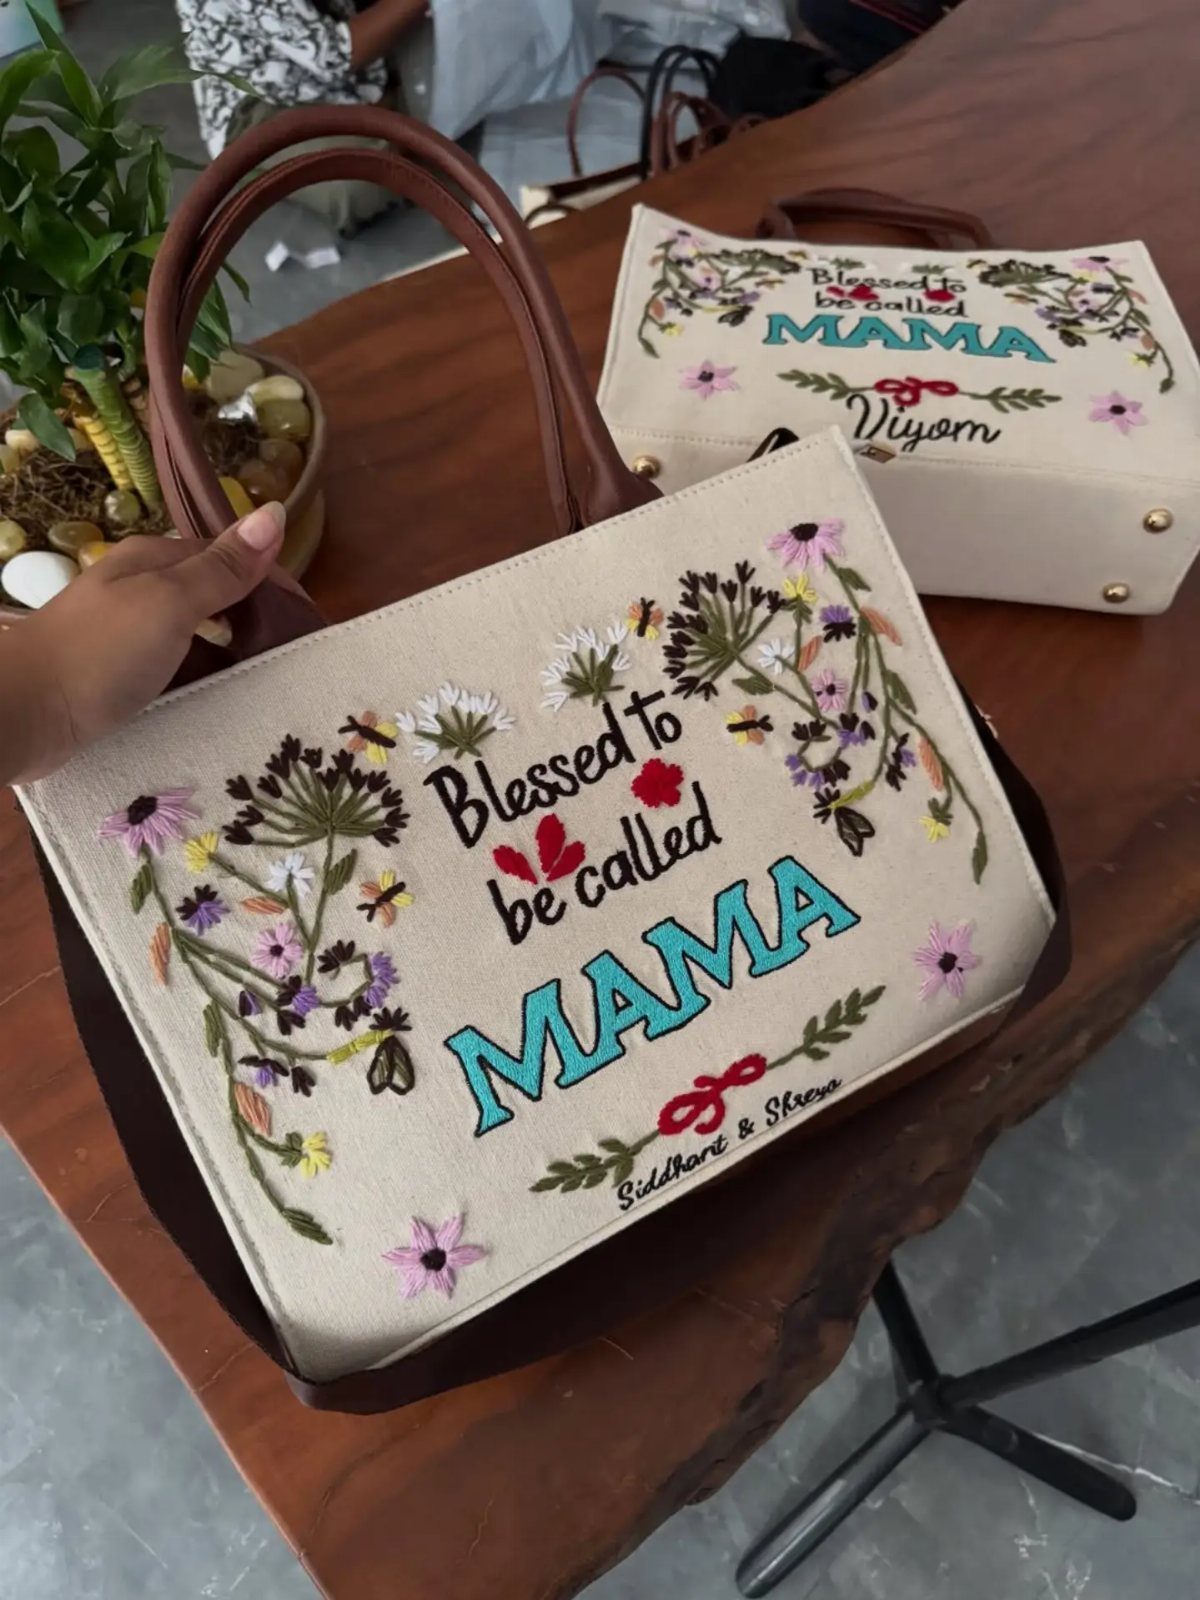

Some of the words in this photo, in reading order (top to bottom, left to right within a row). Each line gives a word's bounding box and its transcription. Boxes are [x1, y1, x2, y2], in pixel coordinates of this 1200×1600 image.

[810, 268, 927, 292] Blessed
[936, 275, 967, 293] to
[815, 290, 855, 309] be
[865, 296, 968, 317] called
[762, 313, 1056, 363] MAMA
[846, 394, 1001, 451] Viyom
[423, 702, 635, 849] Blessed
[623, 690, 682, 750] to
[487, 879, 567, 945] be
[575, 781, 722, 907] called
[444, 855, 861, 1137] MAMA
[738, 1118, 754, 1139] &
